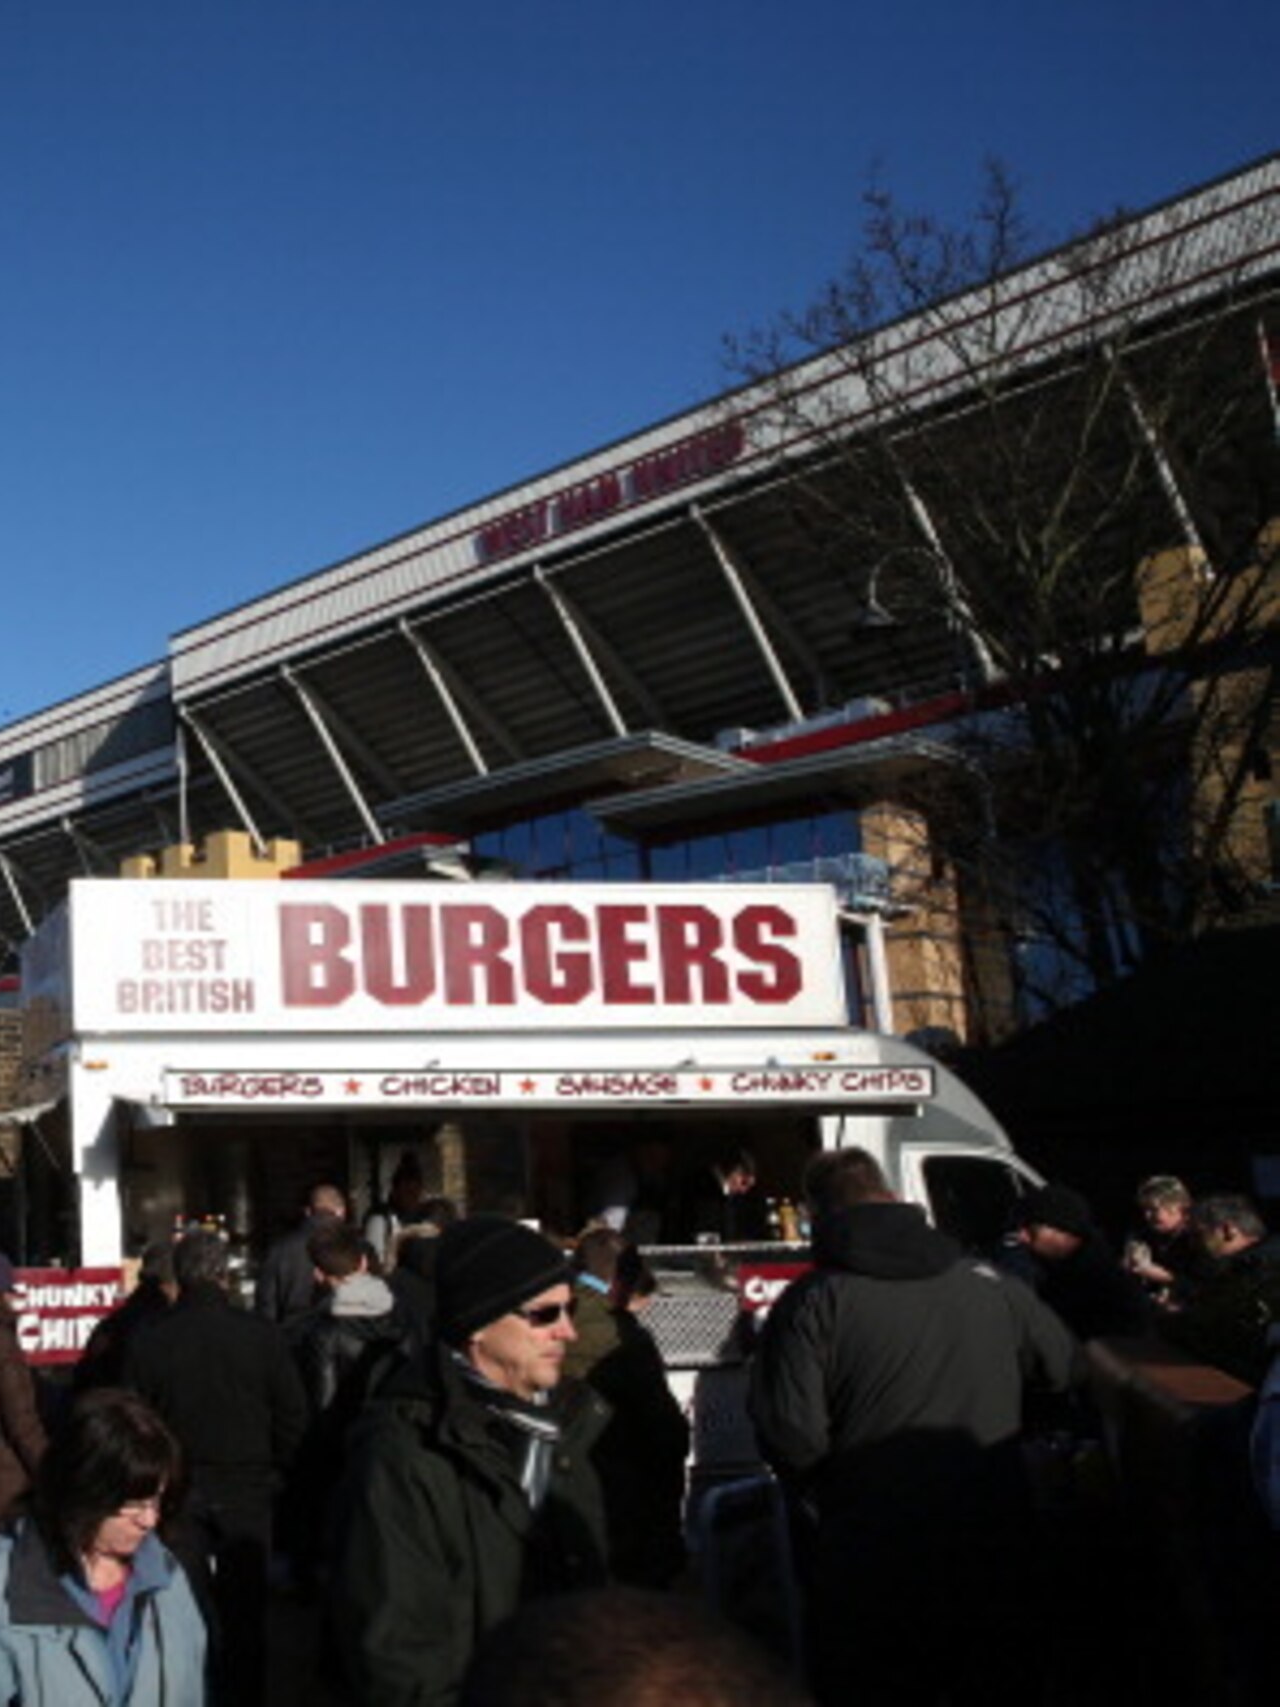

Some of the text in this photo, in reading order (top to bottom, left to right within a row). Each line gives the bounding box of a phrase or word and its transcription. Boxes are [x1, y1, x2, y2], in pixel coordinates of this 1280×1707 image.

[151, 899, 215, 933] THE
[140, 938, 228, 972] BEST
[278, 902, 803, 1007] BURGERS
[116, 978, 256, 1014] BRITISH
[179, 1071, 925, 1099] BURGERS CHICKEN SAUSAGE CHUNKY CHIPS
[17, 1312, 101, 1351] CHIP
